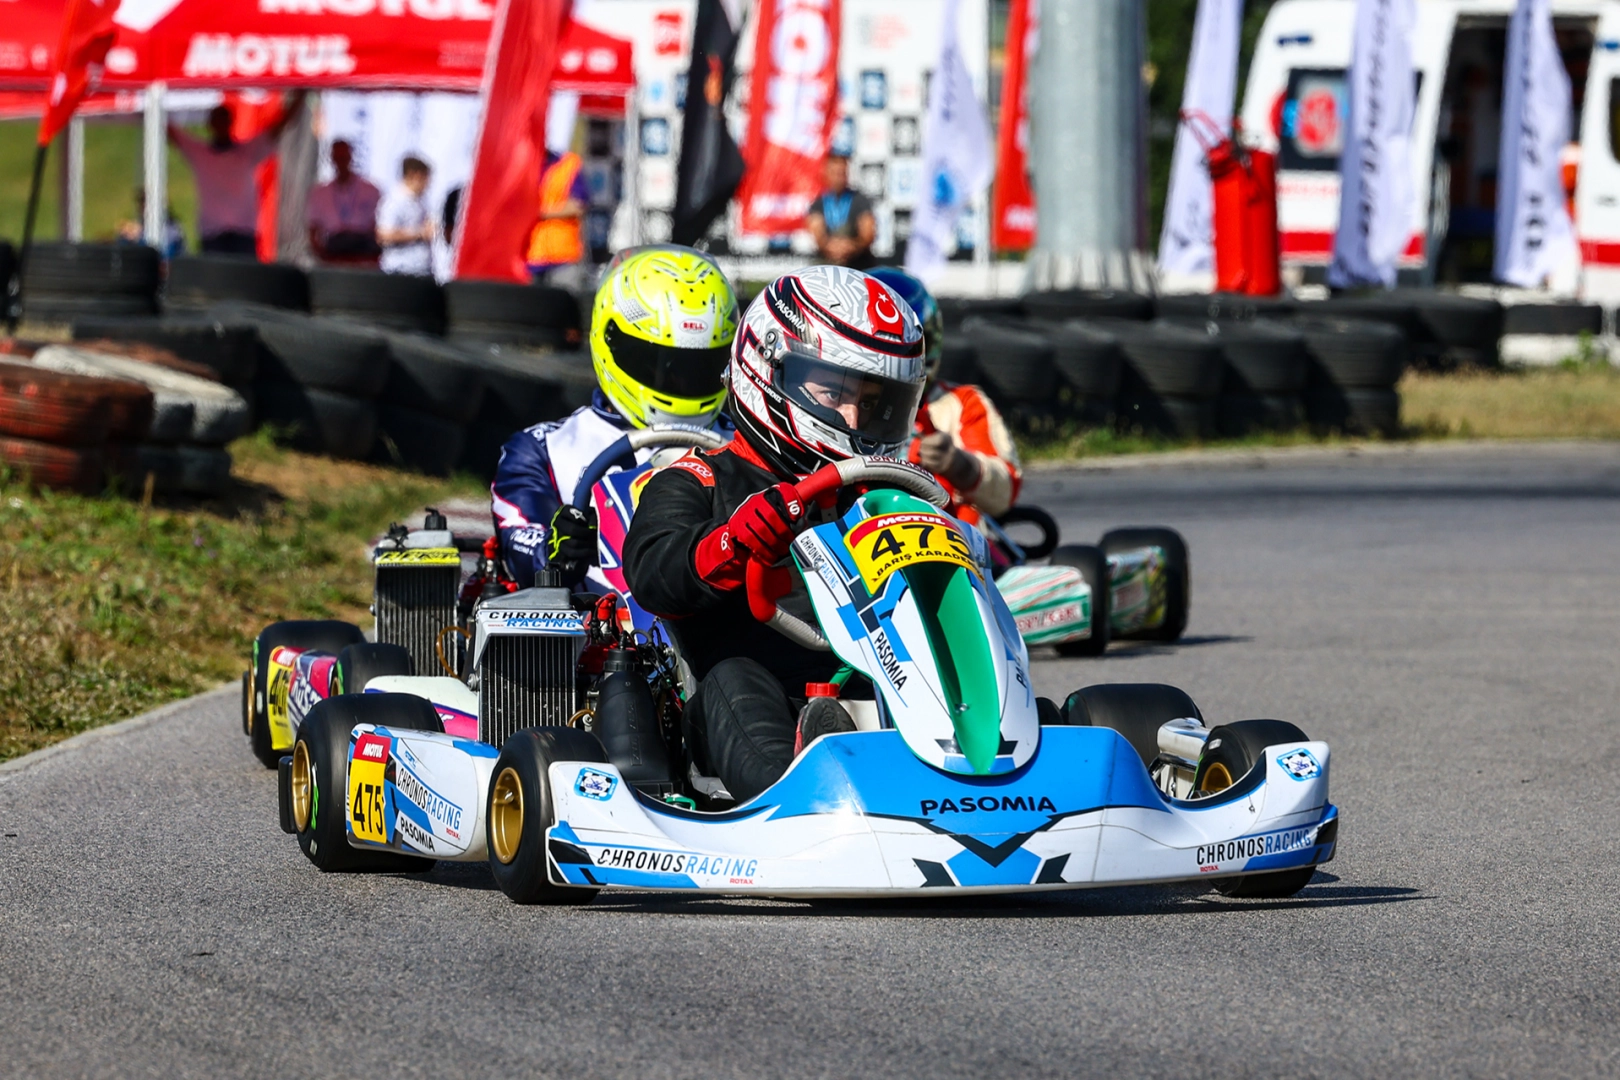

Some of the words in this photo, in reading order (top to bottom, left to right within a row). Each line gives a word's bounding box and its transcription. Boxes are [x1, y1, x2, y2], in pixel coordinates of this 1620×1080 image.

[182, 33, 357, 77] MOTUL
[775, 299, 806, 333] PASOMIA
[683, 322, 705, 330] BELL
[877, 515, 946, 528] MOTUL
[871, 525, 974, 562] 475
[489, 611, 579, 620] CHRONOS
[506, 619, 577, 628] RACING
[874, 632, 908, 691] PASOMIA
[362, 742, 384, 758] MOTUL
[353, 782, 383, 836] 475
[920, 796, 1057, 816] PASOMIA
[400, 816, 436, 853] PASOMIA
[1200, 865, 1219, 873] ROTAX
[729, 877, 754, 885] ROTAX
